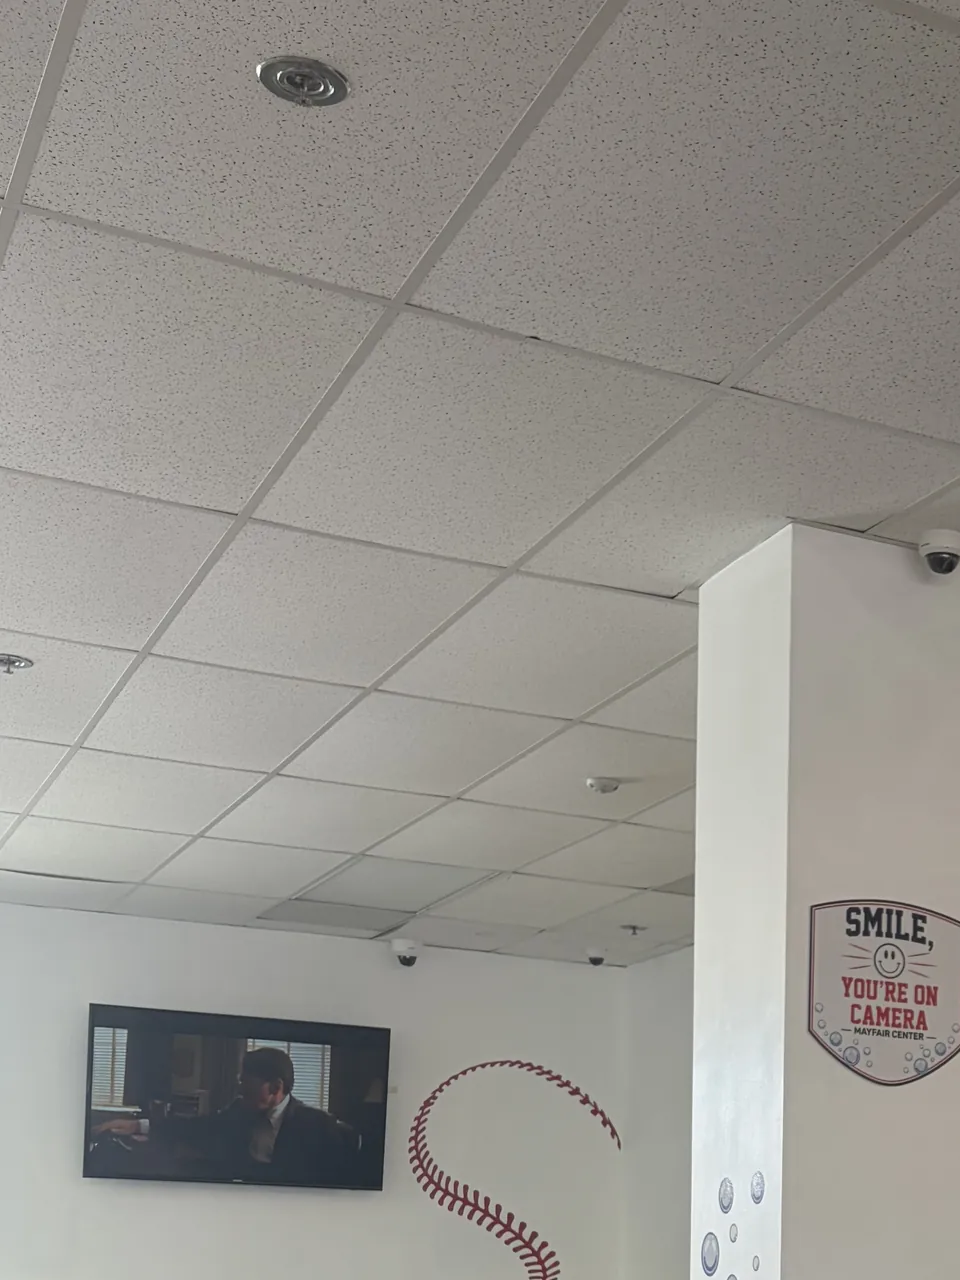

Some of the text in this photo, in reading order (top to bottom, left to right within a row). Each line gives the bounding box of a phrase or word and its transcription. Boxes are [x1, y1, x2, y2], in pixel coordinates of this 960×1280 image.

[845, 906, 934, 952] SMILE,
[841, 976, 939, 1007] YOU'RE ON
[850, 1003, 929, 1031] CAMERA
[854, 1026, 925, 1041] MAYFAIR CENTER
